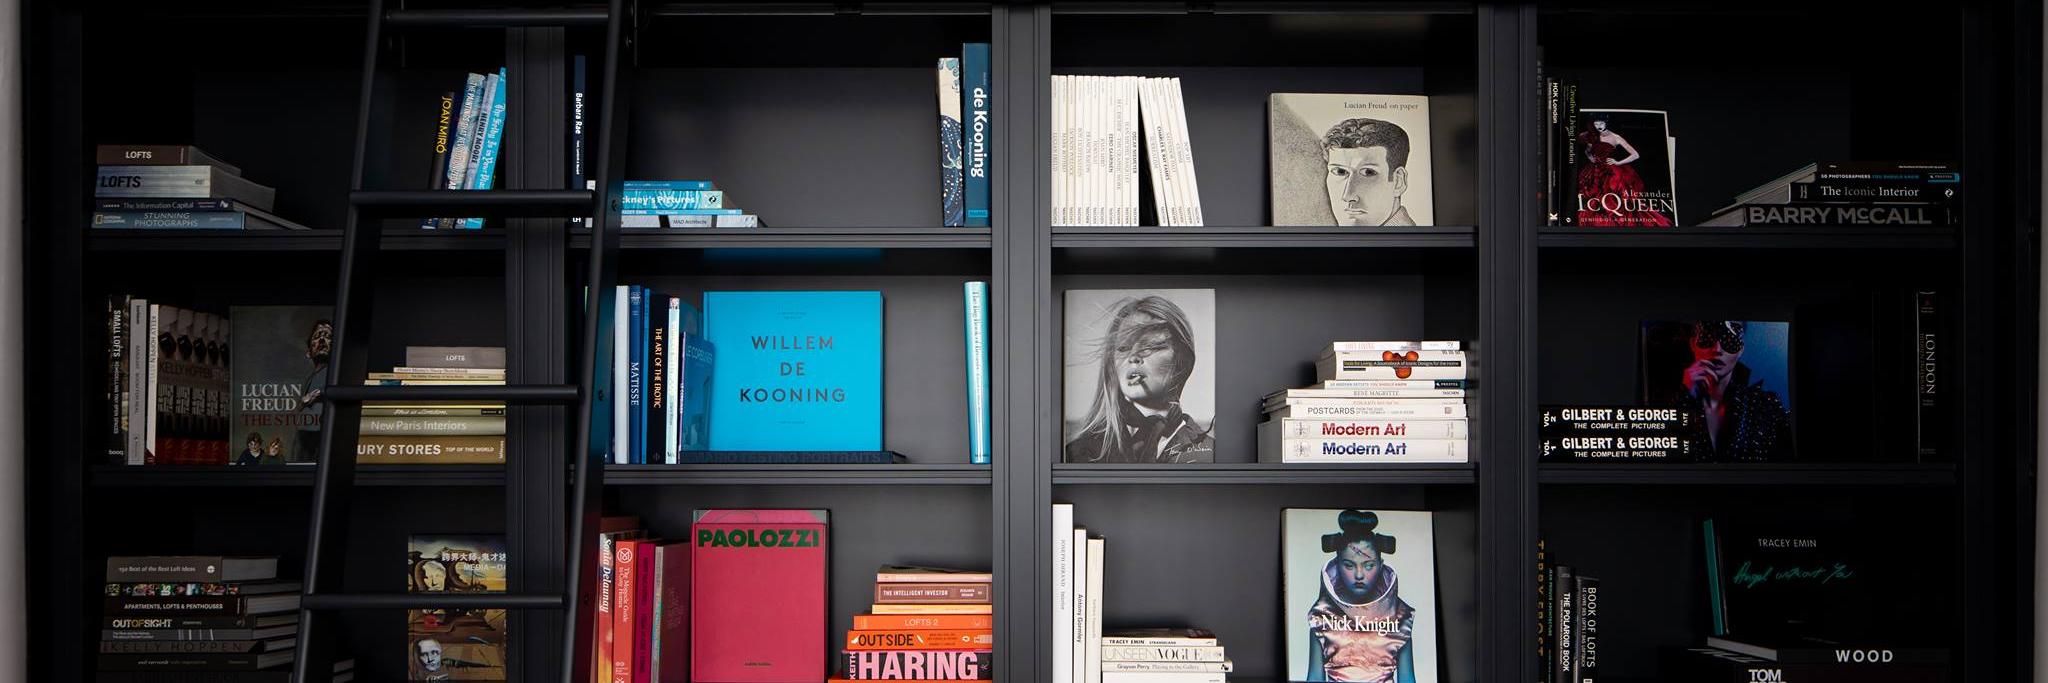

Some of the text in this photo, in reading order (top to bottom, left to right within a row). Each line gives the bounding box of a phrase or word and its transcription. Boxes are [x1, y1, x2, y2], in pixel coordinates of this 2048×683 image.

[575, 93, 583, 121] Barbara
[436, 96, 452, 154] JOAN MIRÓ
[575, 121, 583, 135] Rae
[1568, 115, 1576, 138] Living
[472, 112, 488, 163] HENRY MOORE
[970, 87, 988, 178] de Kooning
[125, 151, 152, 159] LOFTS
[1568, 138, 1576, 164] London
[101, 176, 141, 188] LOFTS
[1623, 190, 1670, 198] Alexander
[1821, 186, 1919, 196] The Iconic Interior
[172, 202, 194, 210] Capital
[1751, 207, 1834, 224] BARRY
[134, 219, 198, 227] PHOTOGRAPHS
[655, 327, 663, 341] THE
[113, 336, 121, 358] LOFTS
[751, 336, 833, 350] WILLEM
[655, 357, 662, 367] OF
[1925, 334, 1936, 394] LONDON
[780, 362, 805, 376] DE
[242, 384, 302, 397] LUCIAN
[631, 362, 639, 406] MATISSE
[654, 383, 662, 408] EROTIC
[740, 388, 846, 402] KOONING
[242, 398, 297, 411] FREUD
[243, 413, 272, 426] THE
[1562, 409, 1677, 422] GILBERT & GEORGE
[371, 421, 466, 431] New Paris Interiors
[1322, 423, 1406, 436] Modern Art
[1591, 422, 1628, 430] COMPLETE
[1632, 422, 1666, 430] PICTURES
[357, 445, 384, 455] URY
[389, 444, 441, 455] STORES
[1322, 443, 1406, 455] Modern Art
[1562, 437, 1678, 450] GILBERT & GEORGE
[1591, 450, 1629, 458] COMPLETE
[1632, 450, 1667, 458] PICTURES
[698, 530, 820, 547] PAOLOZZI
[1758, 538, 1816, 548] TRACEY EMIN
[600, 539, 615, 613] Sonia Delaunay
[1563, 592, 1571, 607] THE
[124, 603, 162, 611] APARTMENTS,
[112, 619, 172, 628] OUTOFSIGHT
[1322, 615, 1400, 636] Nick Knight
[1586, 587, 1597, 668] BOOK OF LOFTS
[111, 641, 242, 651] KELLY HOPPEN
[858, 634, 914, 647] OUTSIDE
[1158, 648, 1203, 660] VOGUE
[1836, 650, 1893, 662] WOOD
[859, 652, 978, 680] HARING
[1562, 650, 1570, 672] BOOK
[1748, 669, 1781, 682] TOM
